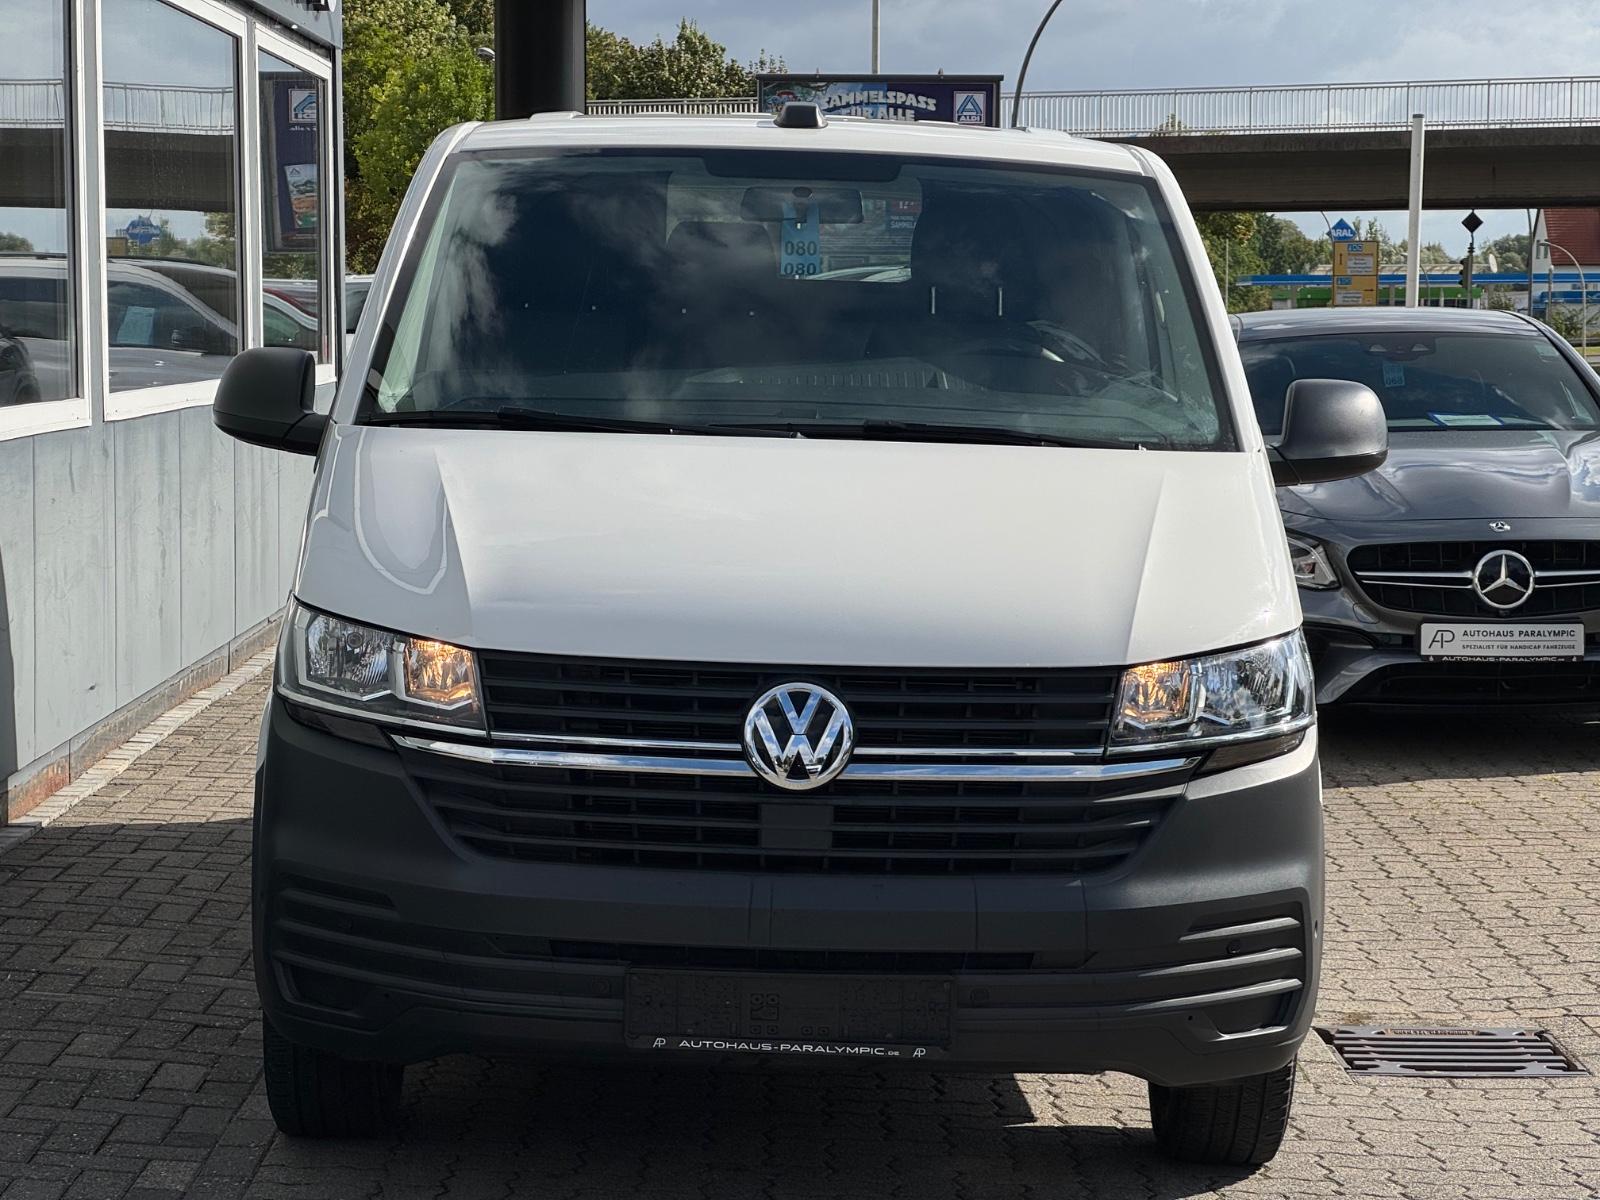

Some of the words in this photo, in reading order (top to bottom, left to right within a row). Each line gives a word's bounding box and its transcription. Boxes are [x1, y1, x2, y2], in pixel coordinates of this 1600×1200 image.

[877, 108, 916, 121] ALLE
[784, 241, 817, 256] 080
[784, 263, 817, 275] 080
[1462, 630, 1514, 638] AUTOHAUS
[1518, 630, 1576, 638] PARALYMPIC
[750, 686, 848, 784] VW
